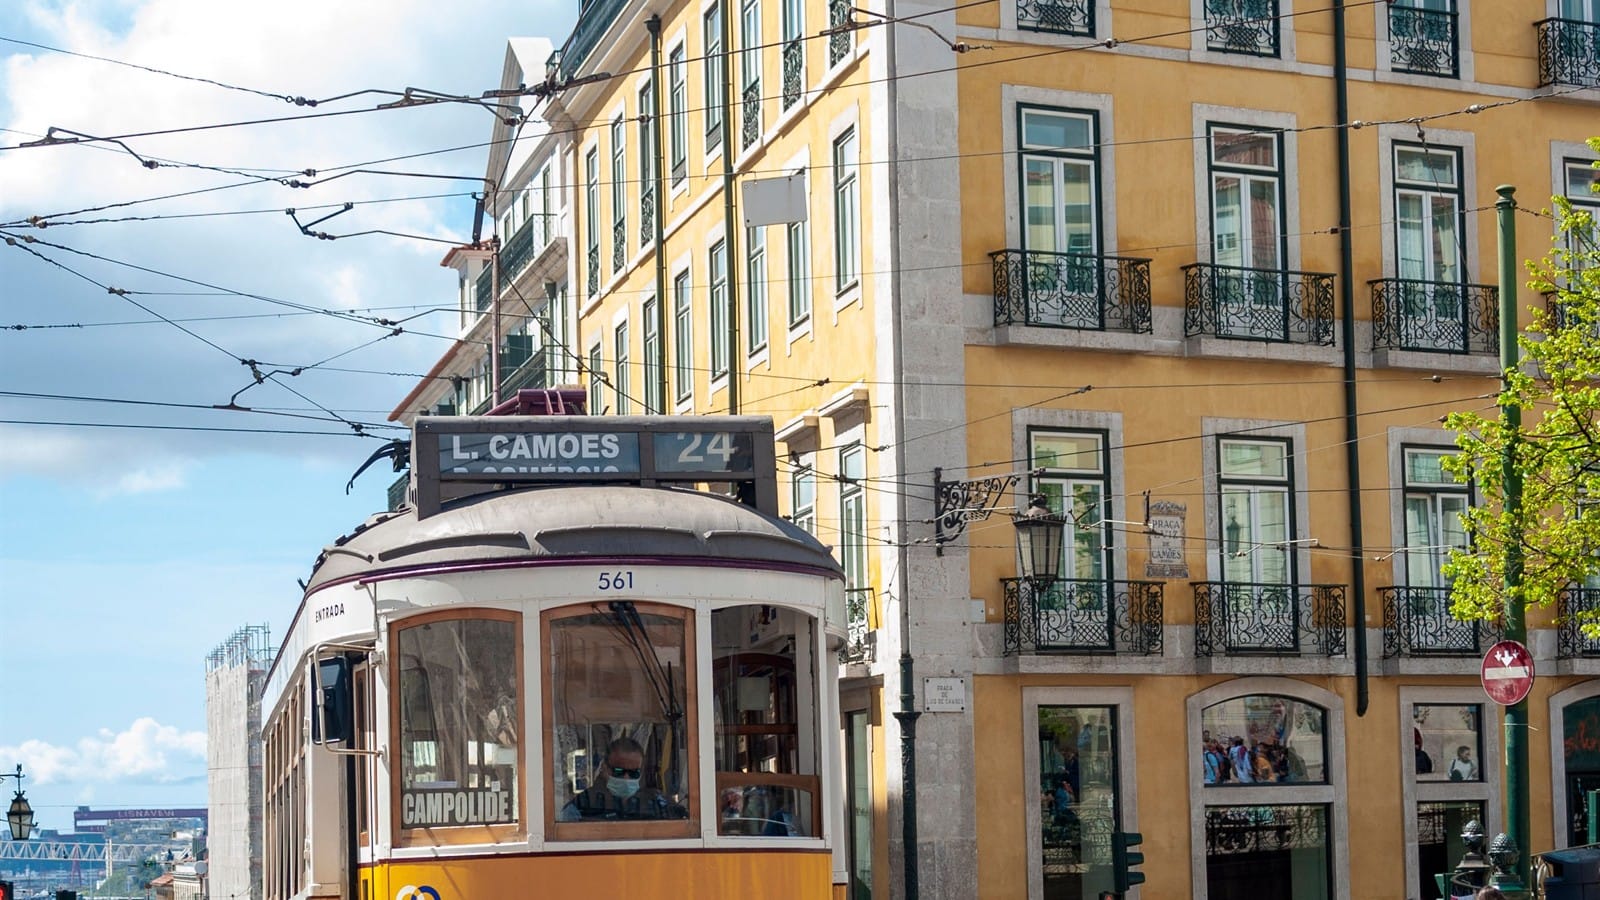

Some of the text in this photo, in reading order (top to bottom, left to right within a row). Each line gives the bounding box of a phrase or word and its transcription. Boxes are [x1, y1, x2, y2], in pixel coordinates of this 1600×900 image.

[453, 435, 479, 460] L.
[677, 432, 738, 463] 24
[598, 571, 633, 590] 561
[315, 603, 345, 623] ENTRADA
[402, 791, 509, 825] CAMPOLIDE
